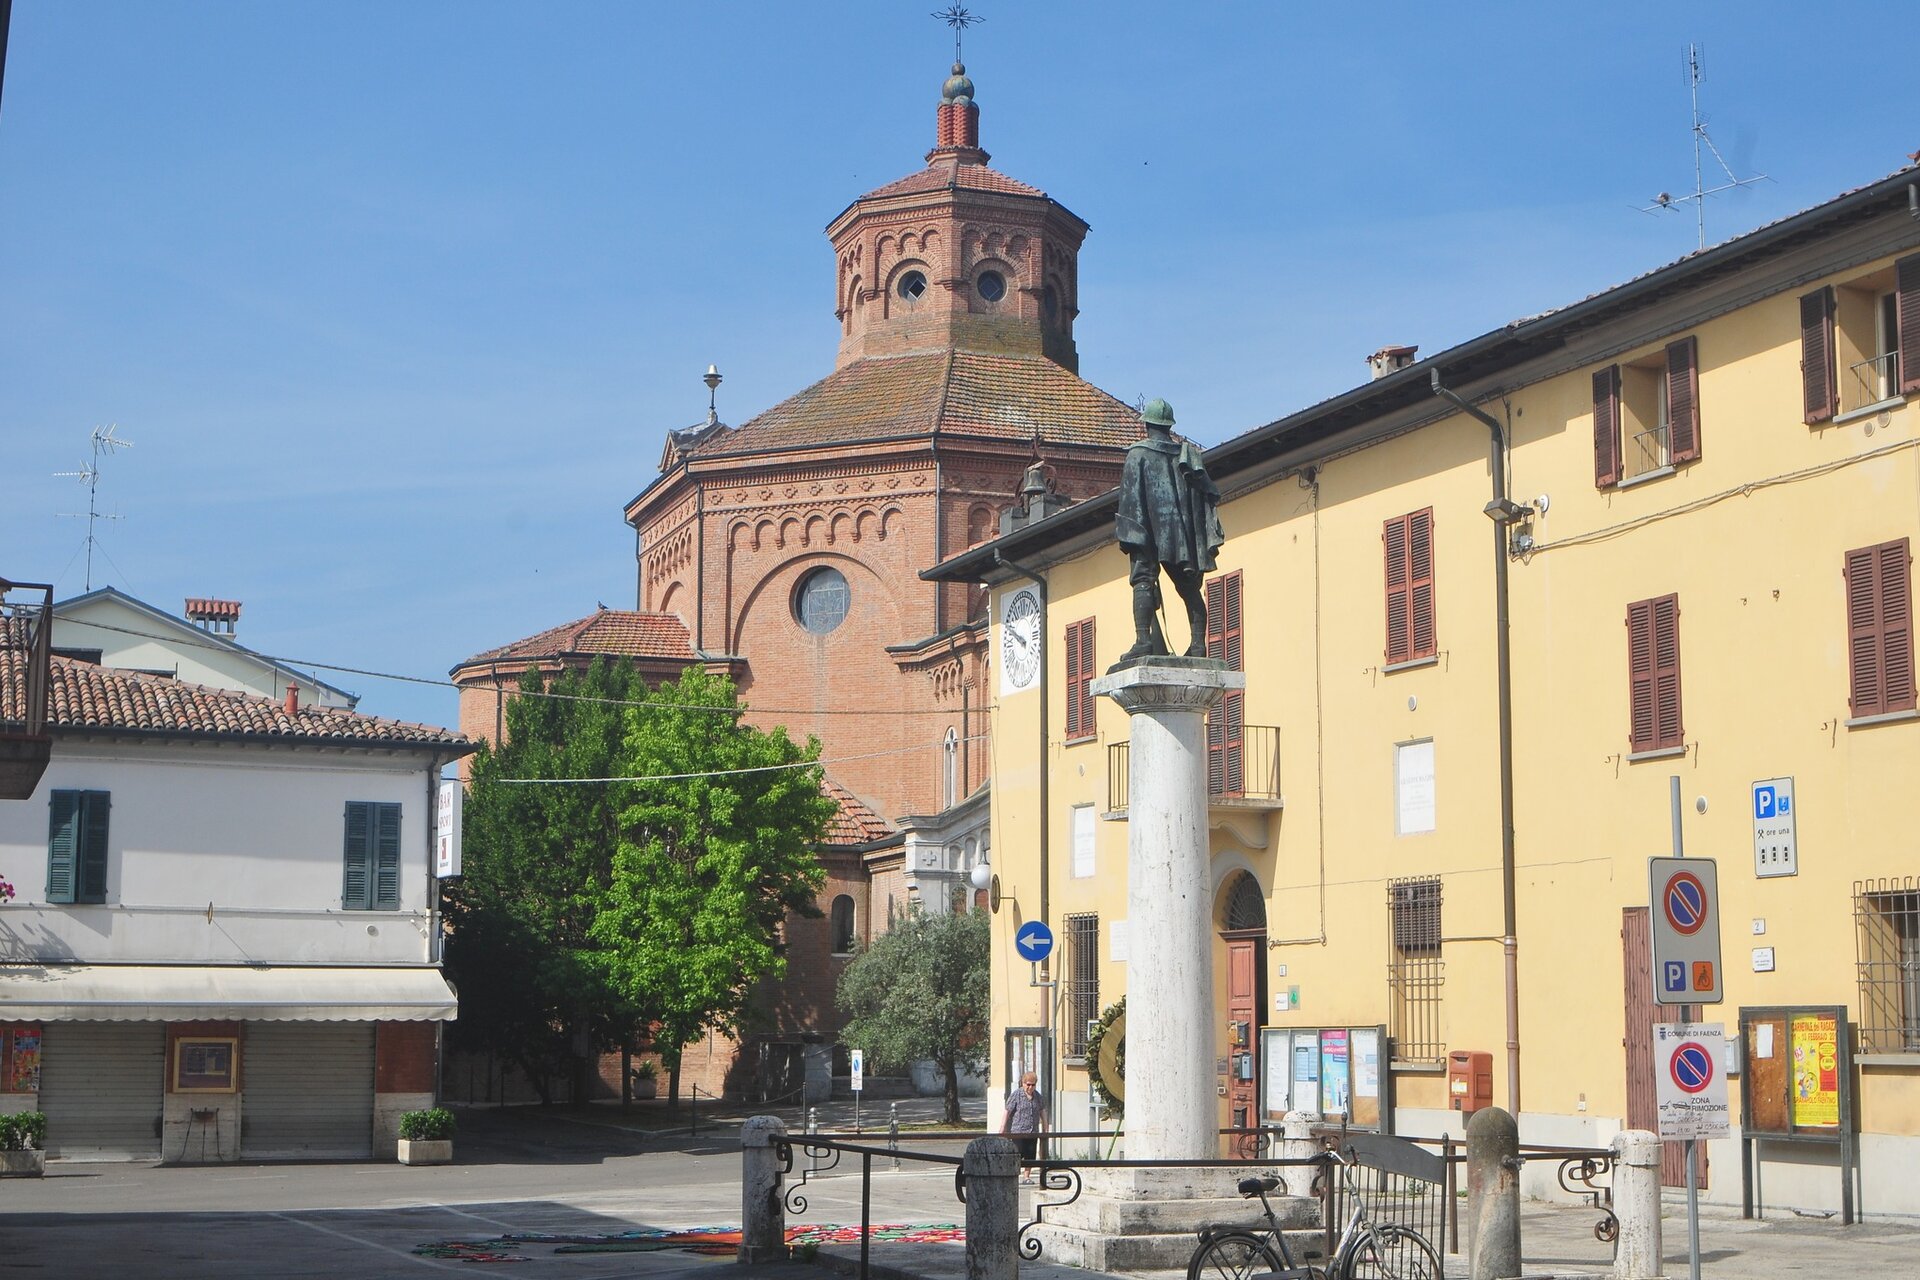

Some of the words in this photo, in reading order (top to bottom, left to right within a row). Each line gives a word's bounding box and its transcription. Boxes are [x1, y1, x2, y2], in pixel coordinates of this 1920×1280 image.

[440, 792, 451, 810] BAR
[1758, 790, 1772, 815] P
[1668, 964, 1681, 988] P
[1691, 1104, 1728, 1112] RIMOZIONE
